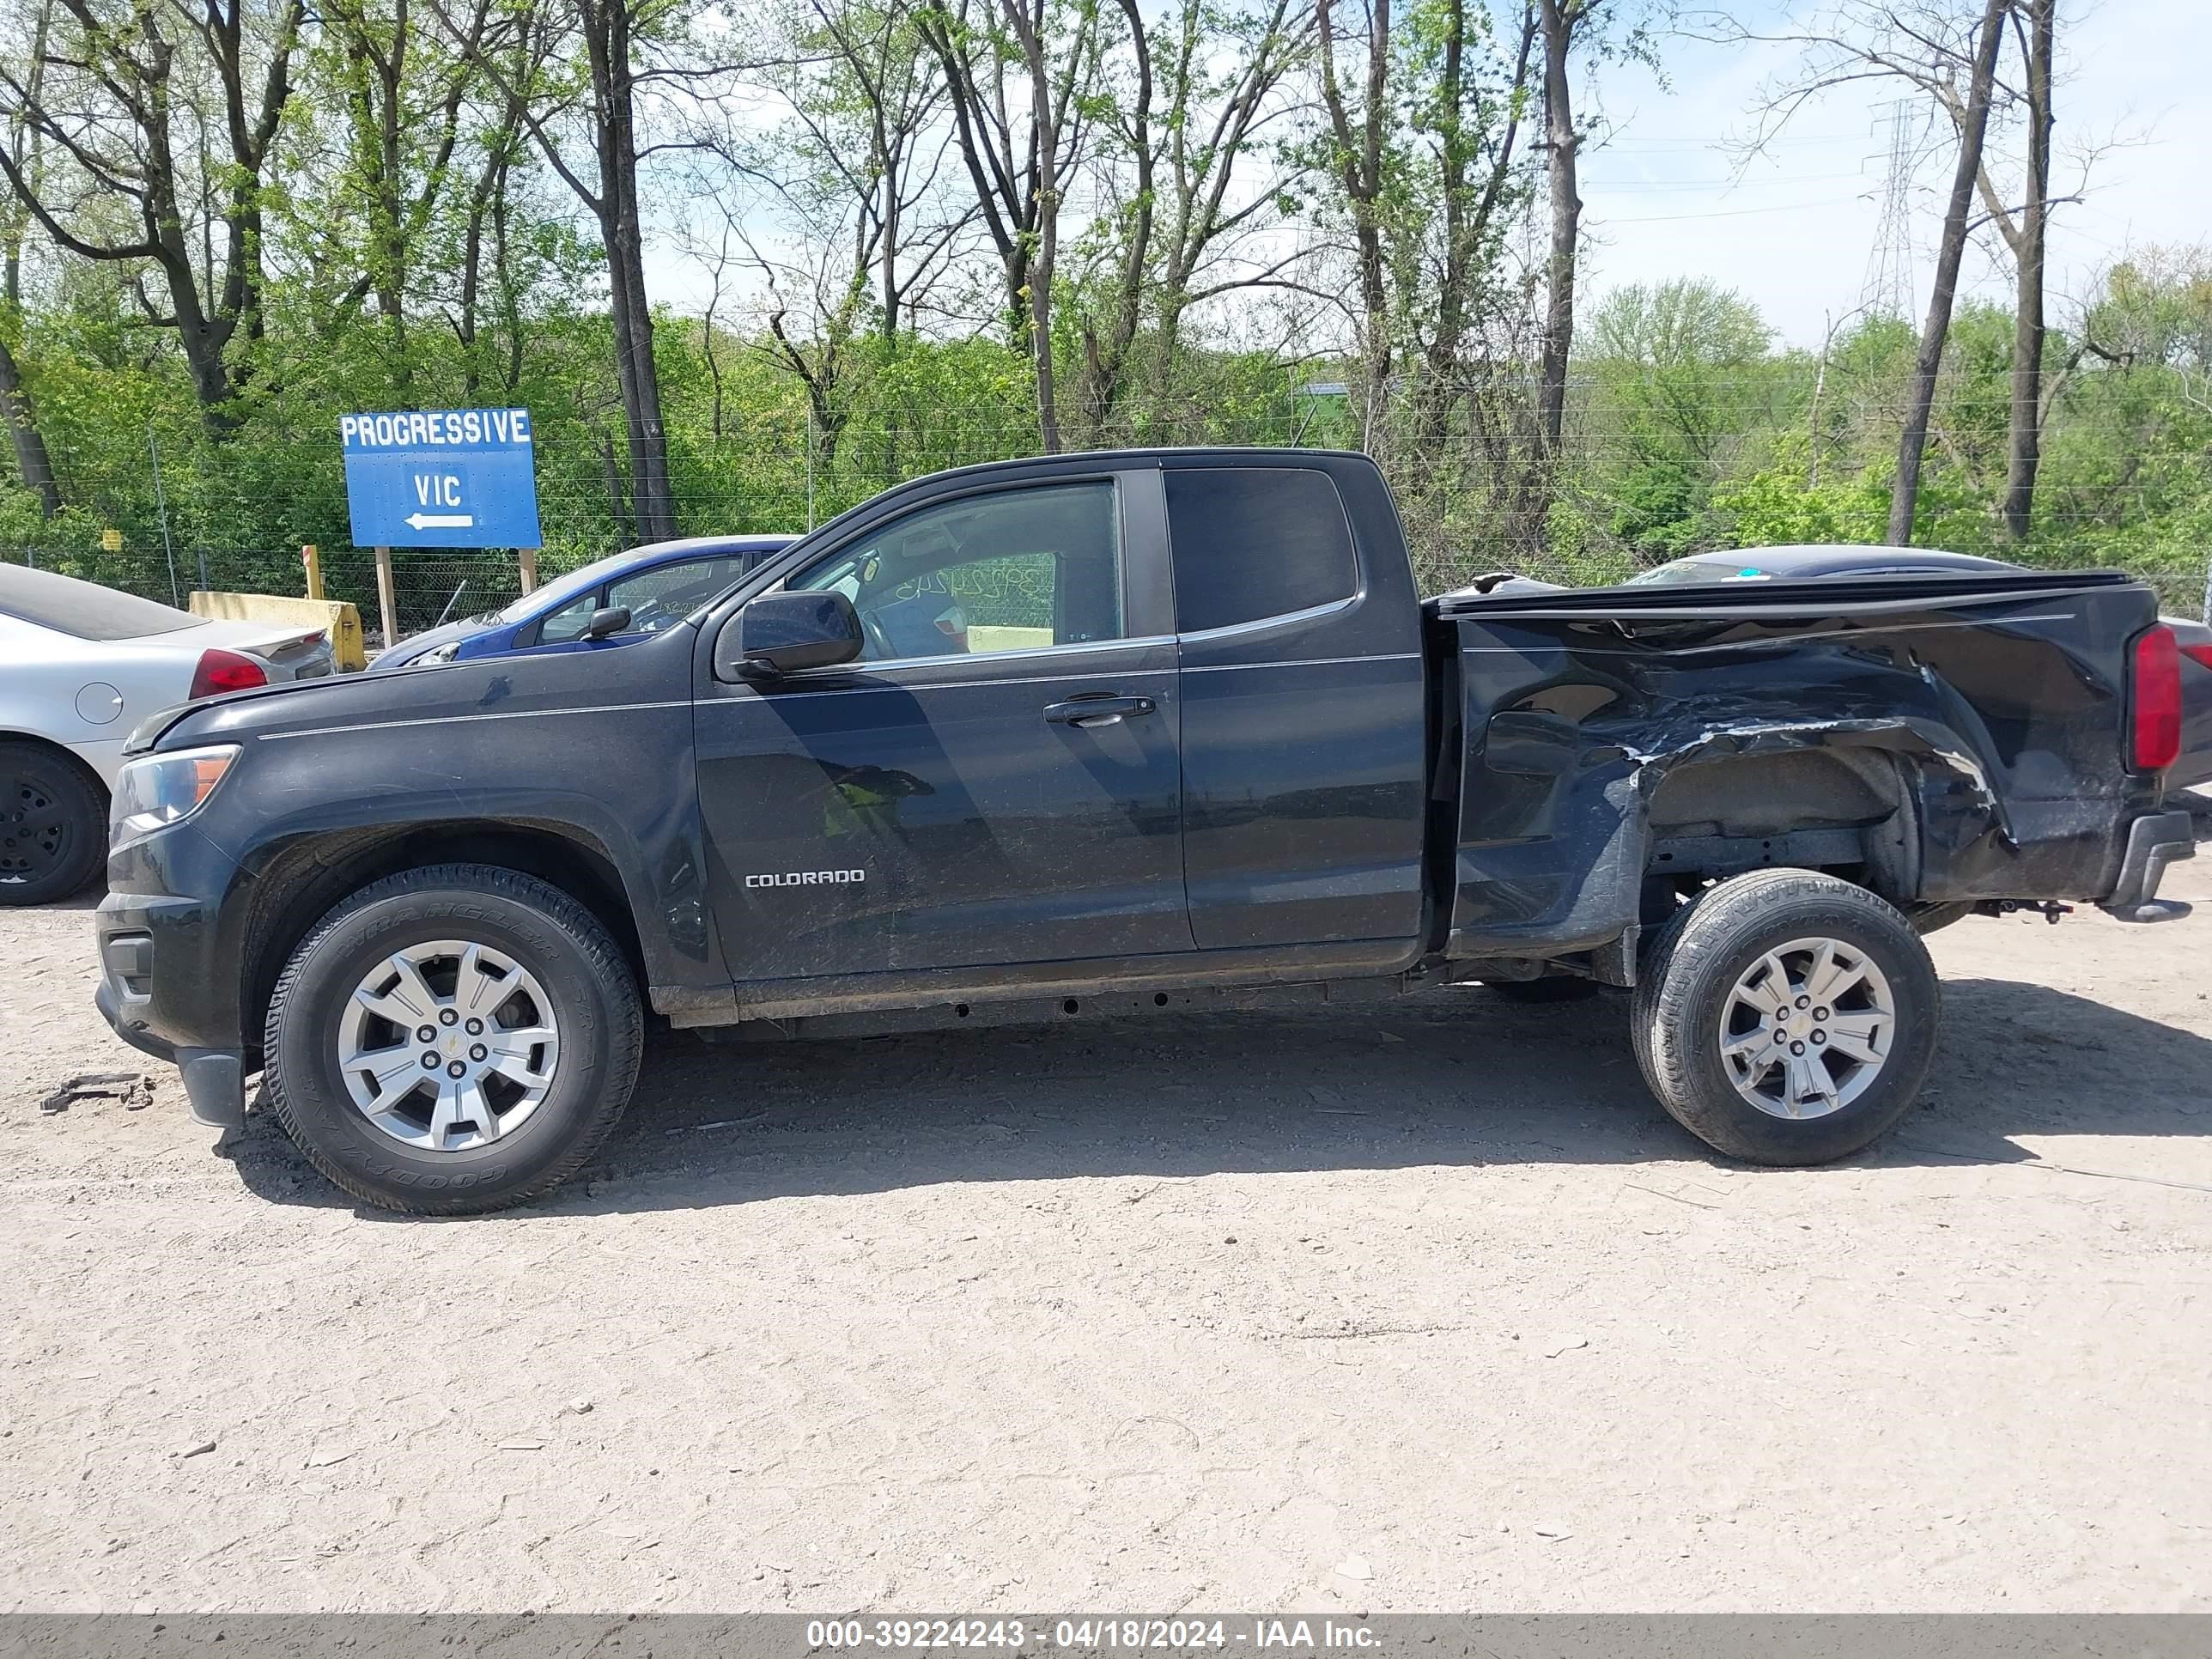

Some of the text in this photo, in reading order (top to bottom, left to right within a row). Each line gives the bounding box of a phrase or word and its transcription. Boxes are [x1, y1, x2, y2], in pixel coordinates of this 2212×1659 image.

[342, 410, 530, 447] PROGRESSIVE
[414, 475, 461, 507] VIC
[745, 869, 866, 888] COLORADO
[336, 903, 560, 961] WRANGLER
